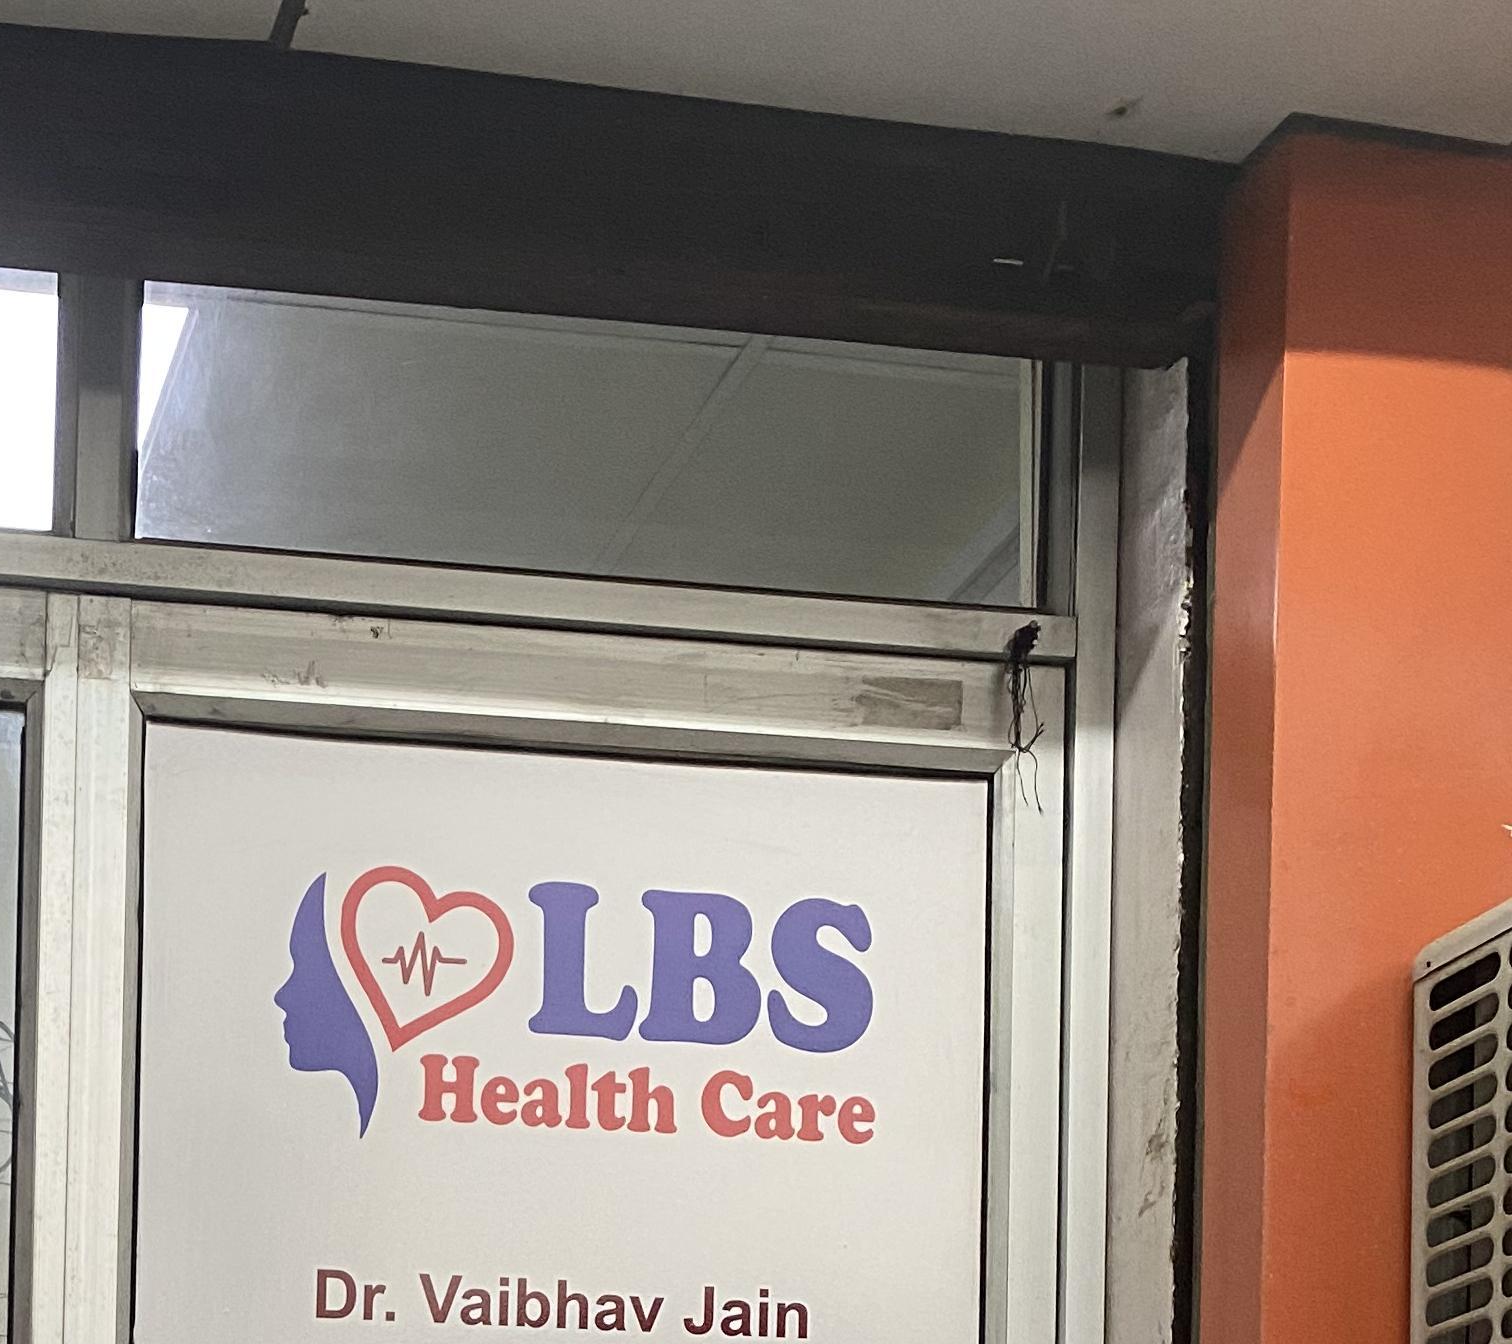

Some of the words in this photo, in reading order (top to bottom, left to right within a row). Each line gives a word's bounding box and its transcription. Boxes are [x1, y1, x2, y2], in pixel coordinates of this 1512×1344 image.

[528, 881, 873, 1053] LBS
[418, 1054, 677, 1134] Health
[701, 1070, 876, 1144] Care
[315, 1268, 395, 1322] Dr.
[419, 1273, 665, 1333] Vaibhav
[683, 1286, 809, 1339] Jain
